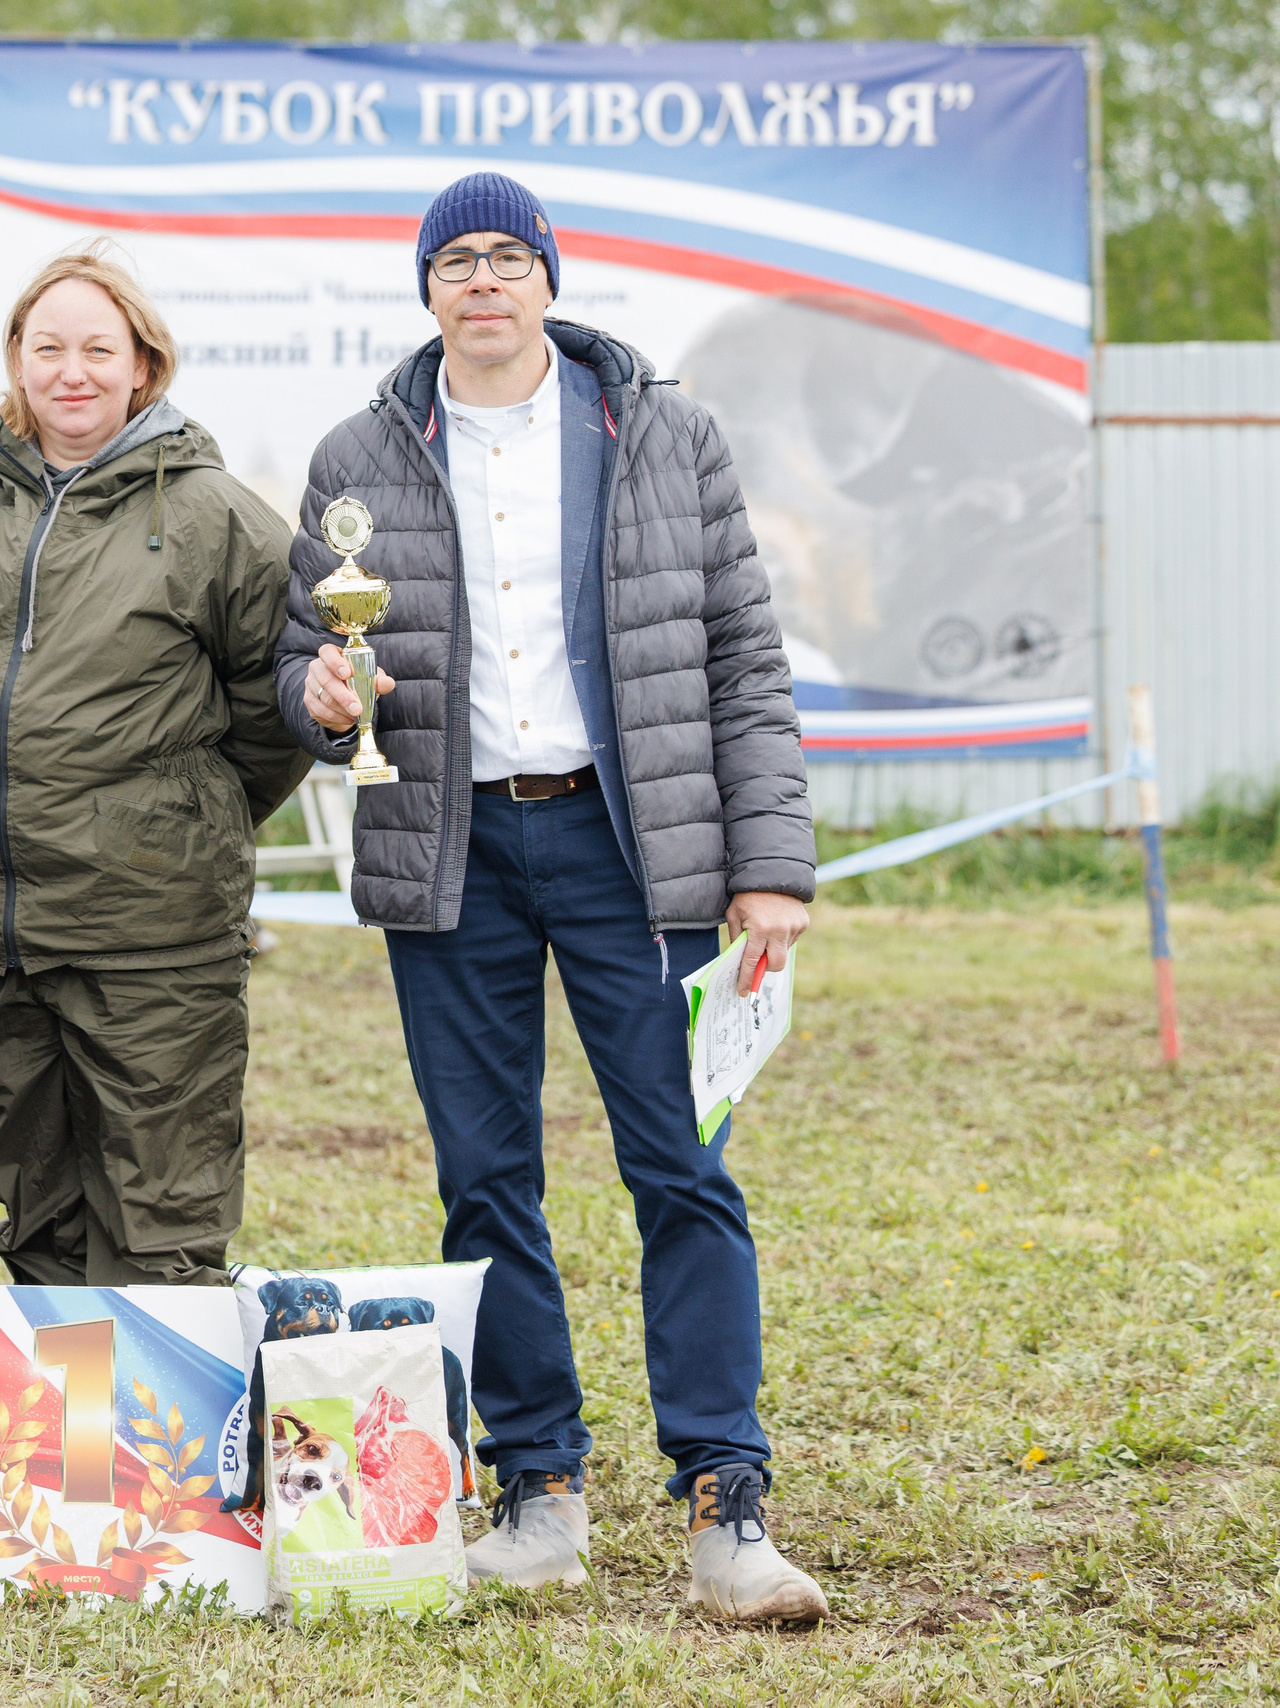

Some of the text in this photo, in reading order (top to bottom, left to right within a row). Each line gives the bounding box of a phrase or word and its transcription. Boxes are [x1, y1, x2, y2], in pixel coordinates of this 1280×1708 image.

[34, 1318, 116, 1505] 1
[63, 1573, 101, 1584] место
[332, 1571, 375, 1580] BALANCE
